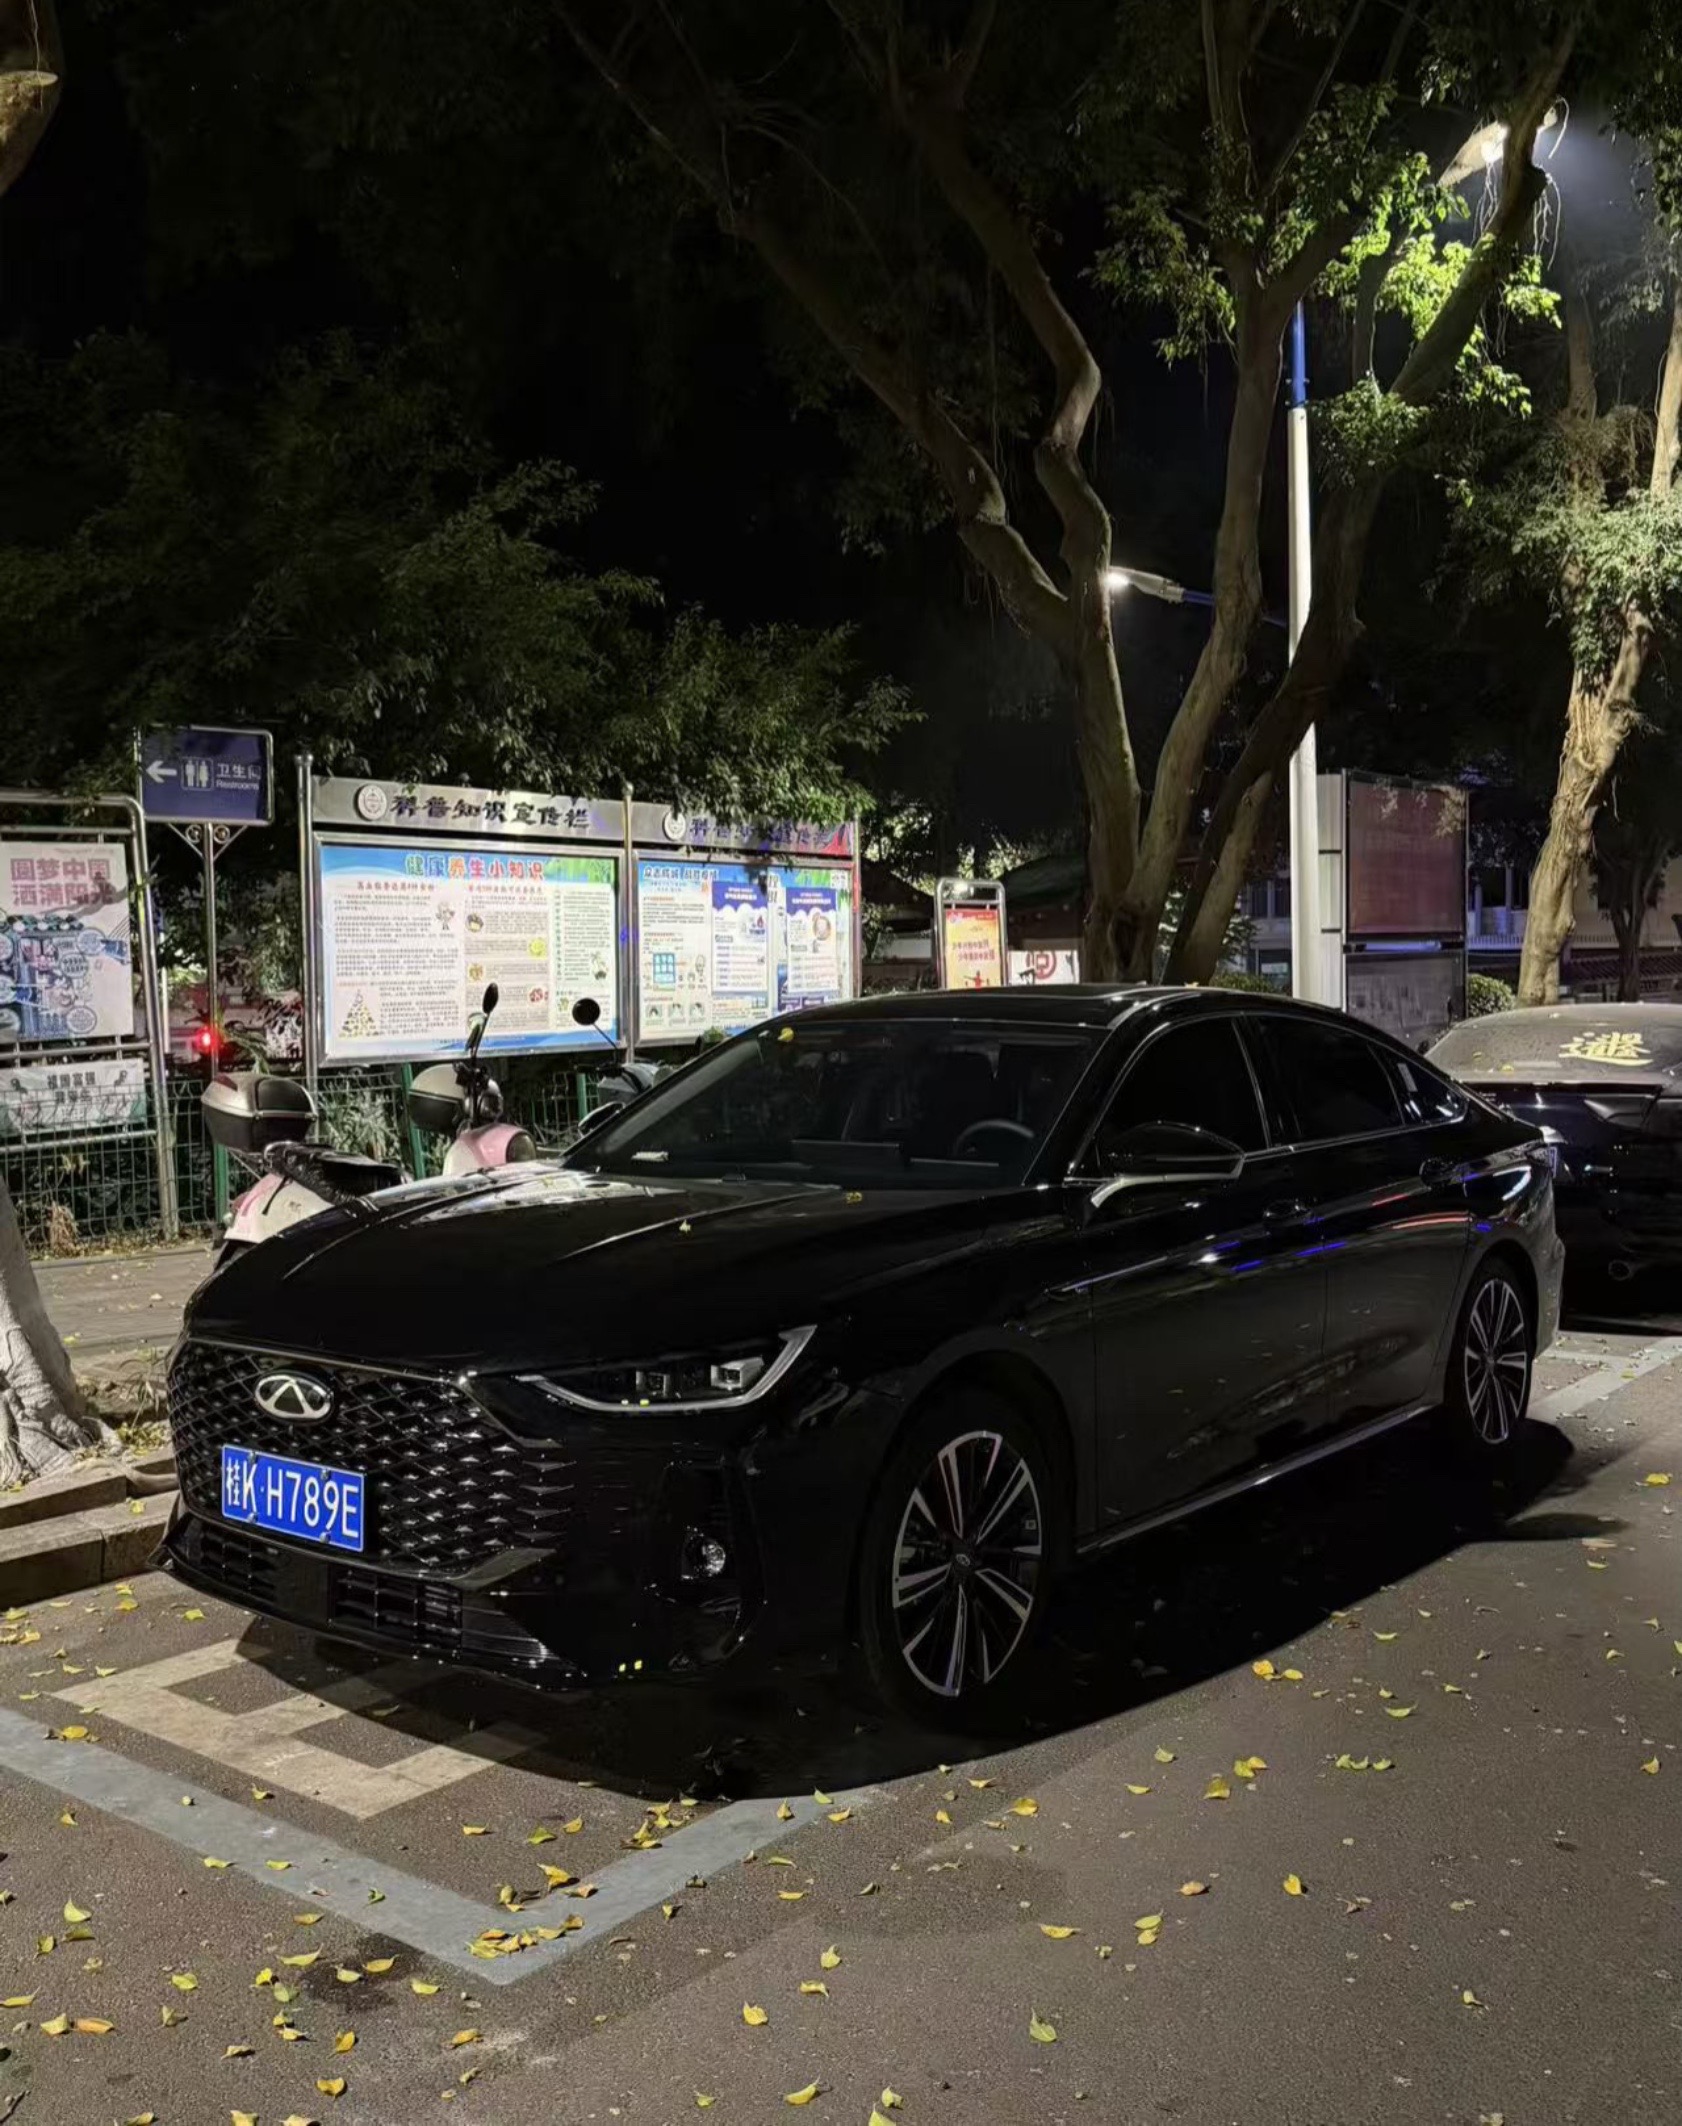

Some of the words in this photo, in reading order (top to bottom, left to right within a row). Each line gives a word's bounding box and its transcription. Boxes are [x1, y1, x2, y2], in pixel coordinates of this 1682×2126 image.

[390, 794, 591, 829] 科普知识宣传栏
[10, 858, 110, 882] 圆梦中国
[406, 853, 545, 881] 健康养生小知识
